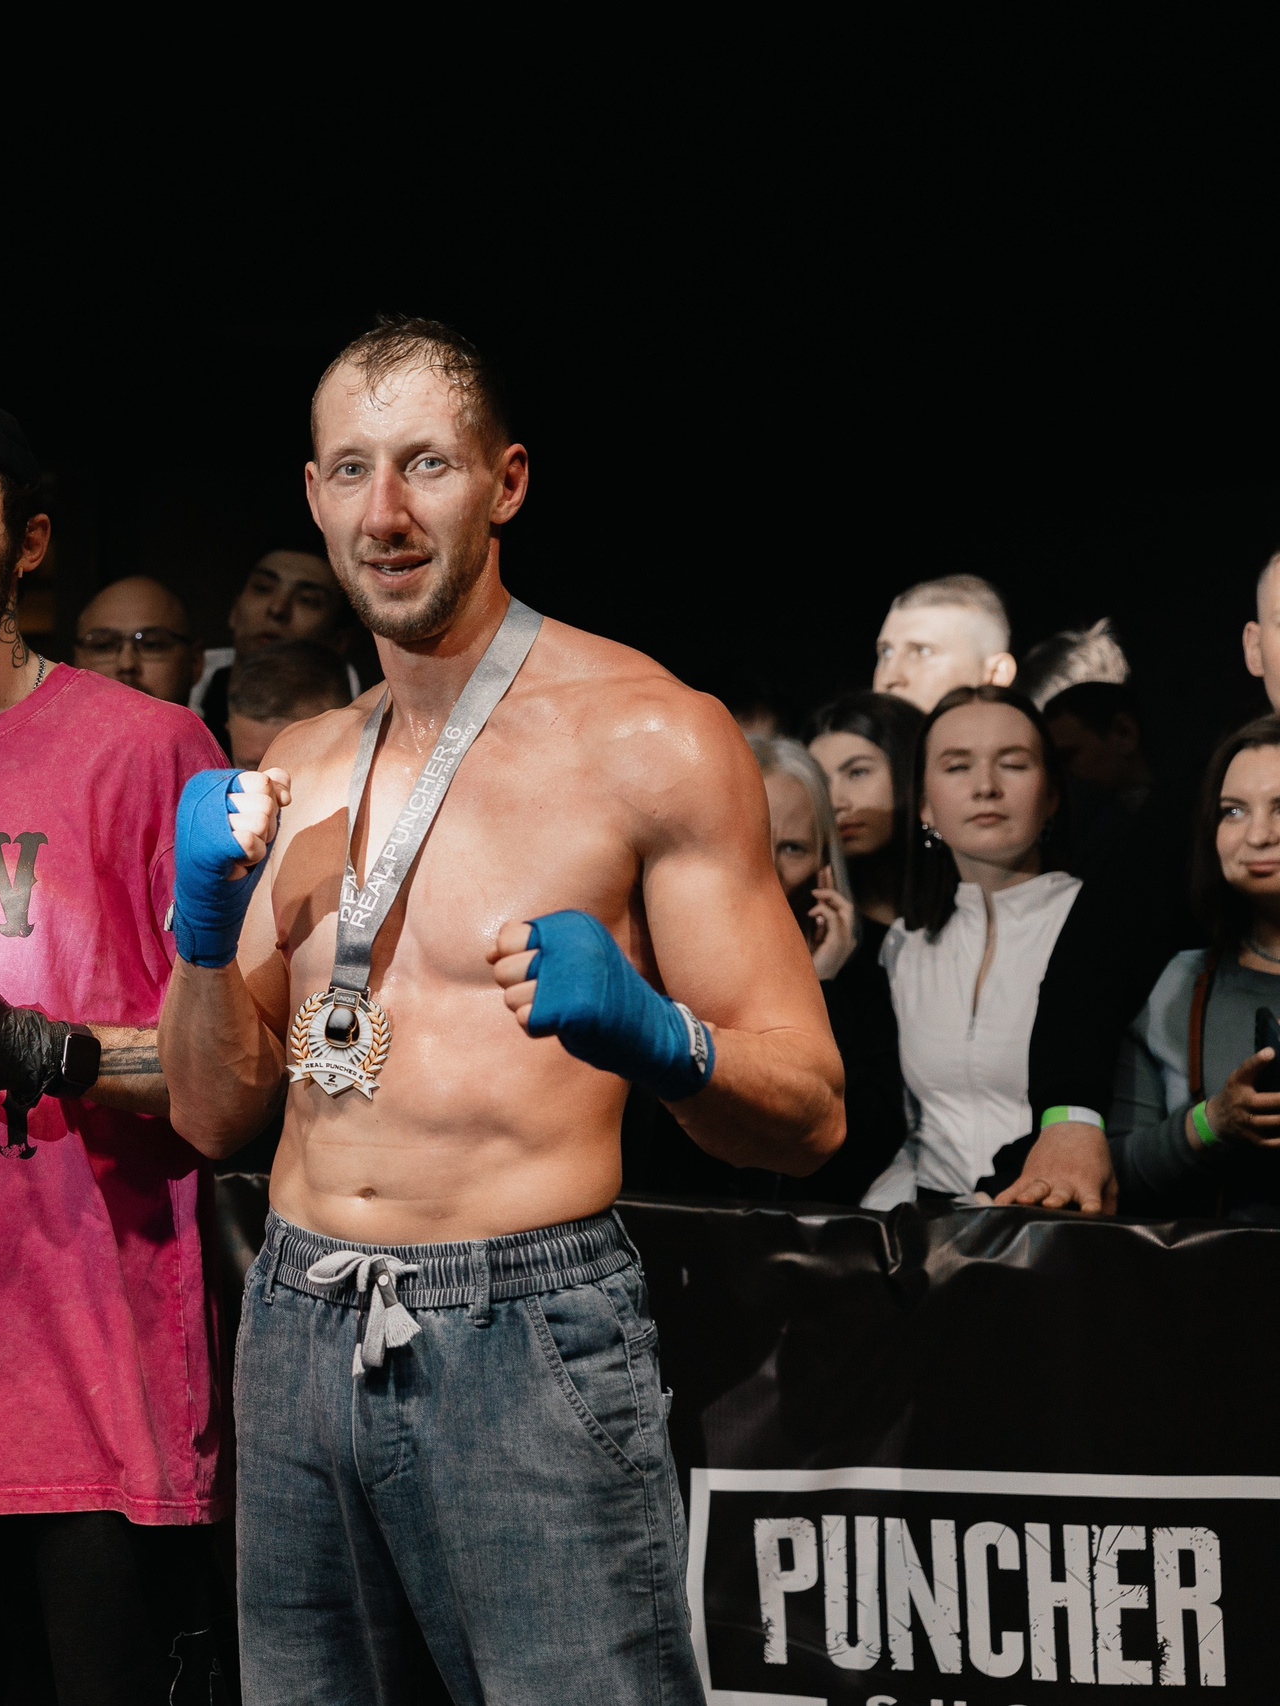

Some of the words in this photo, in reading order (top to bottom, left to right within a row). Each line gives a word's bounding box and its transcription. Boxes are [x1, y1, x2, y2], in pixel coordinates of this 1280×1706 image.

[350, 863, 393, 928] REAL
[382, 745, 453, 861] PUNCHER
[444, 726, 461, 739] 6
[326, 1063, 357, 1075] PUNCHER
[328, 1073, 337, 1083] 2
[753, 1514, 1227, 1687] PUNCHER
